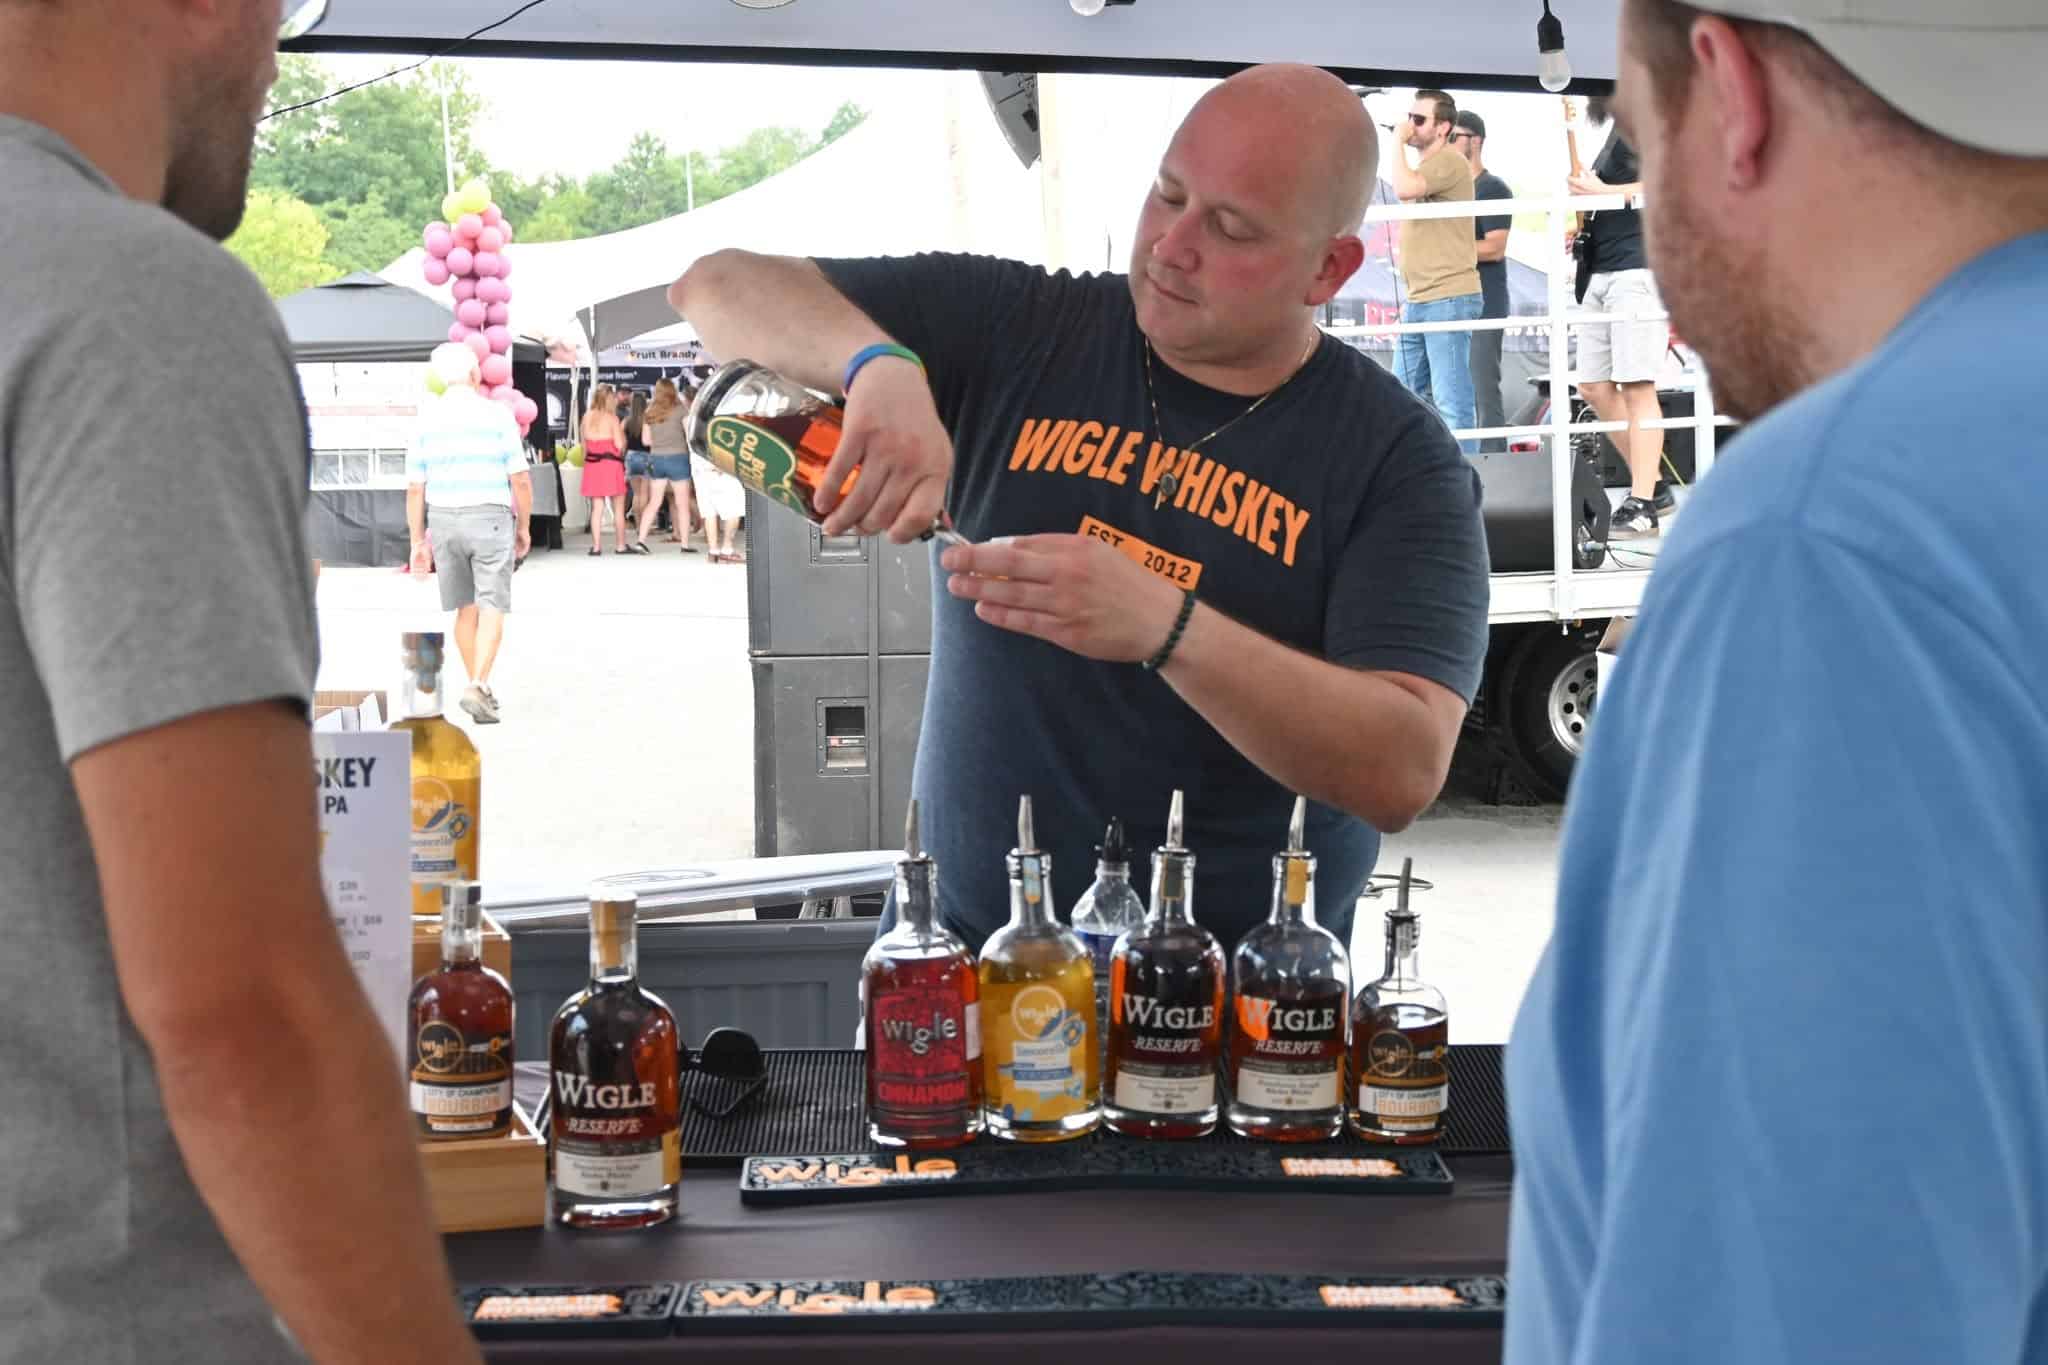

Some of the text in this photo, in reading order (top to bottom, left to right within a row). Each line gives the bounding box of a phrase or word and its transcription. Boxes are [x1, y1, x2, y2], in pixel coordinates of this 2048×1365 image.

[660, 350, 697, 360] Brandy
[1008, 419, 1310, 567] WIGLE WHISKEY
[1143, 550, 1192, 584] 2012
[324, 795, 348, 815] PA
[1134, 1035, 1202, 1054] RESERVE
[1254, 1039, 1322, 1056] RESERVE
[879, 1081, 967, 1105] CINNAMON
[567, 1116, 641, 1136] RESERVE
